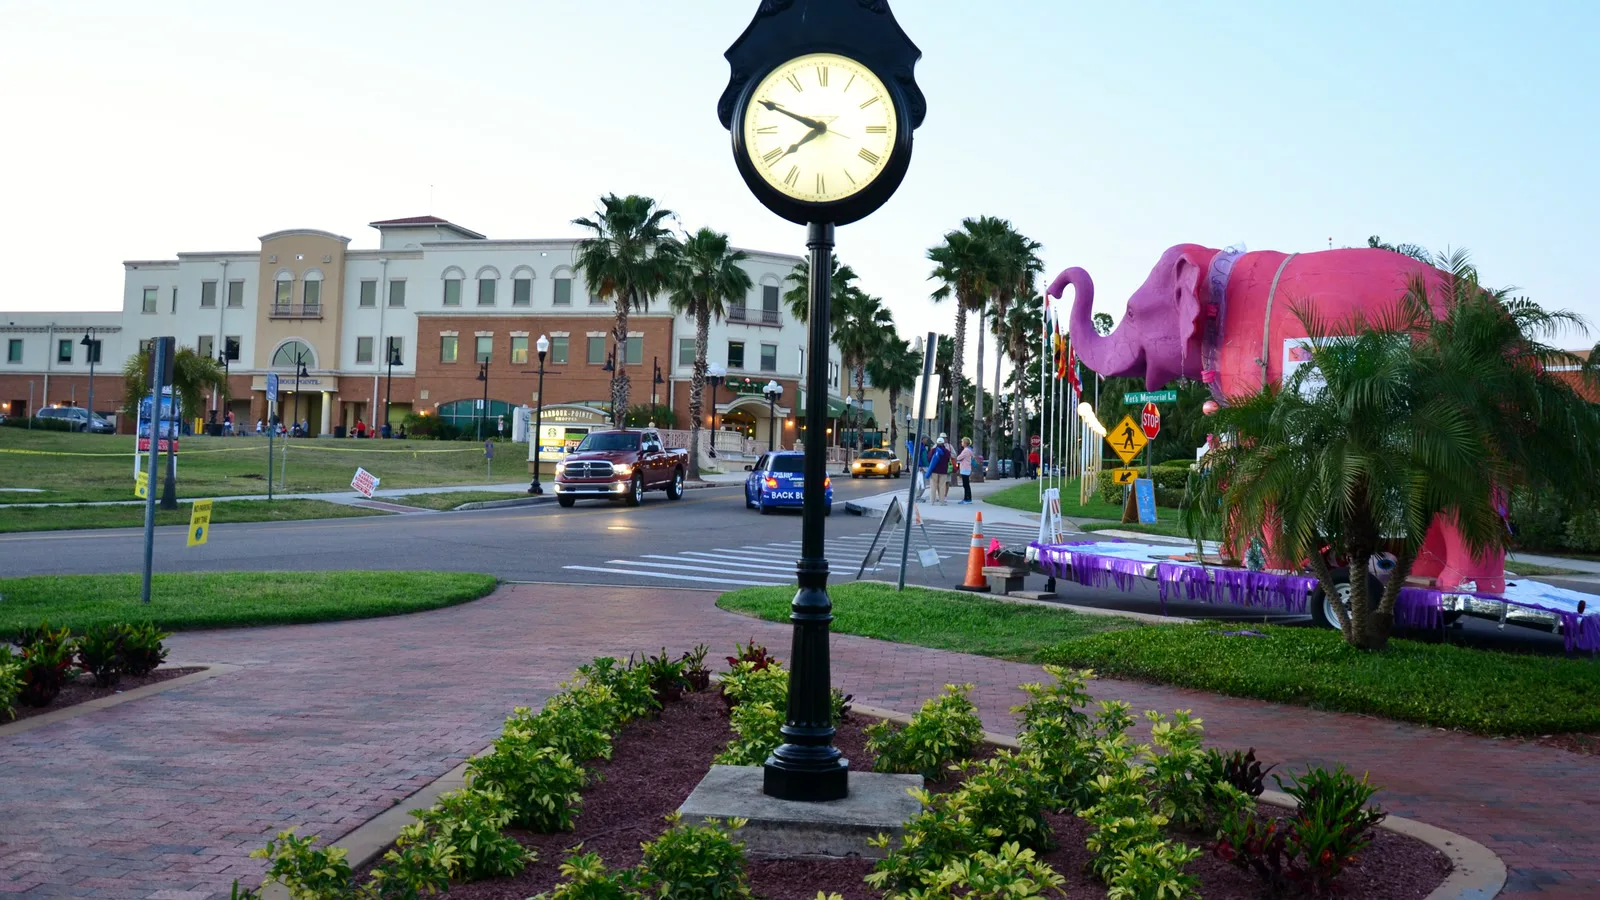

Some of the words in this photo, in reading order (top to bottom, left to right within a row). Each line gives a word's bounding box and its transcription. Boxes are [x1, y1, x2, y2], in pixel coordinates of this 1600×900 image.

[1124, 394, 1139, 403] Vet's
[1140, 393, 1167, 402] Memorial
[1168, 391, 1177, 401] Ln
[1143, 412, 1160, 429] STOP
[771, 491, 794, 499] BACK
